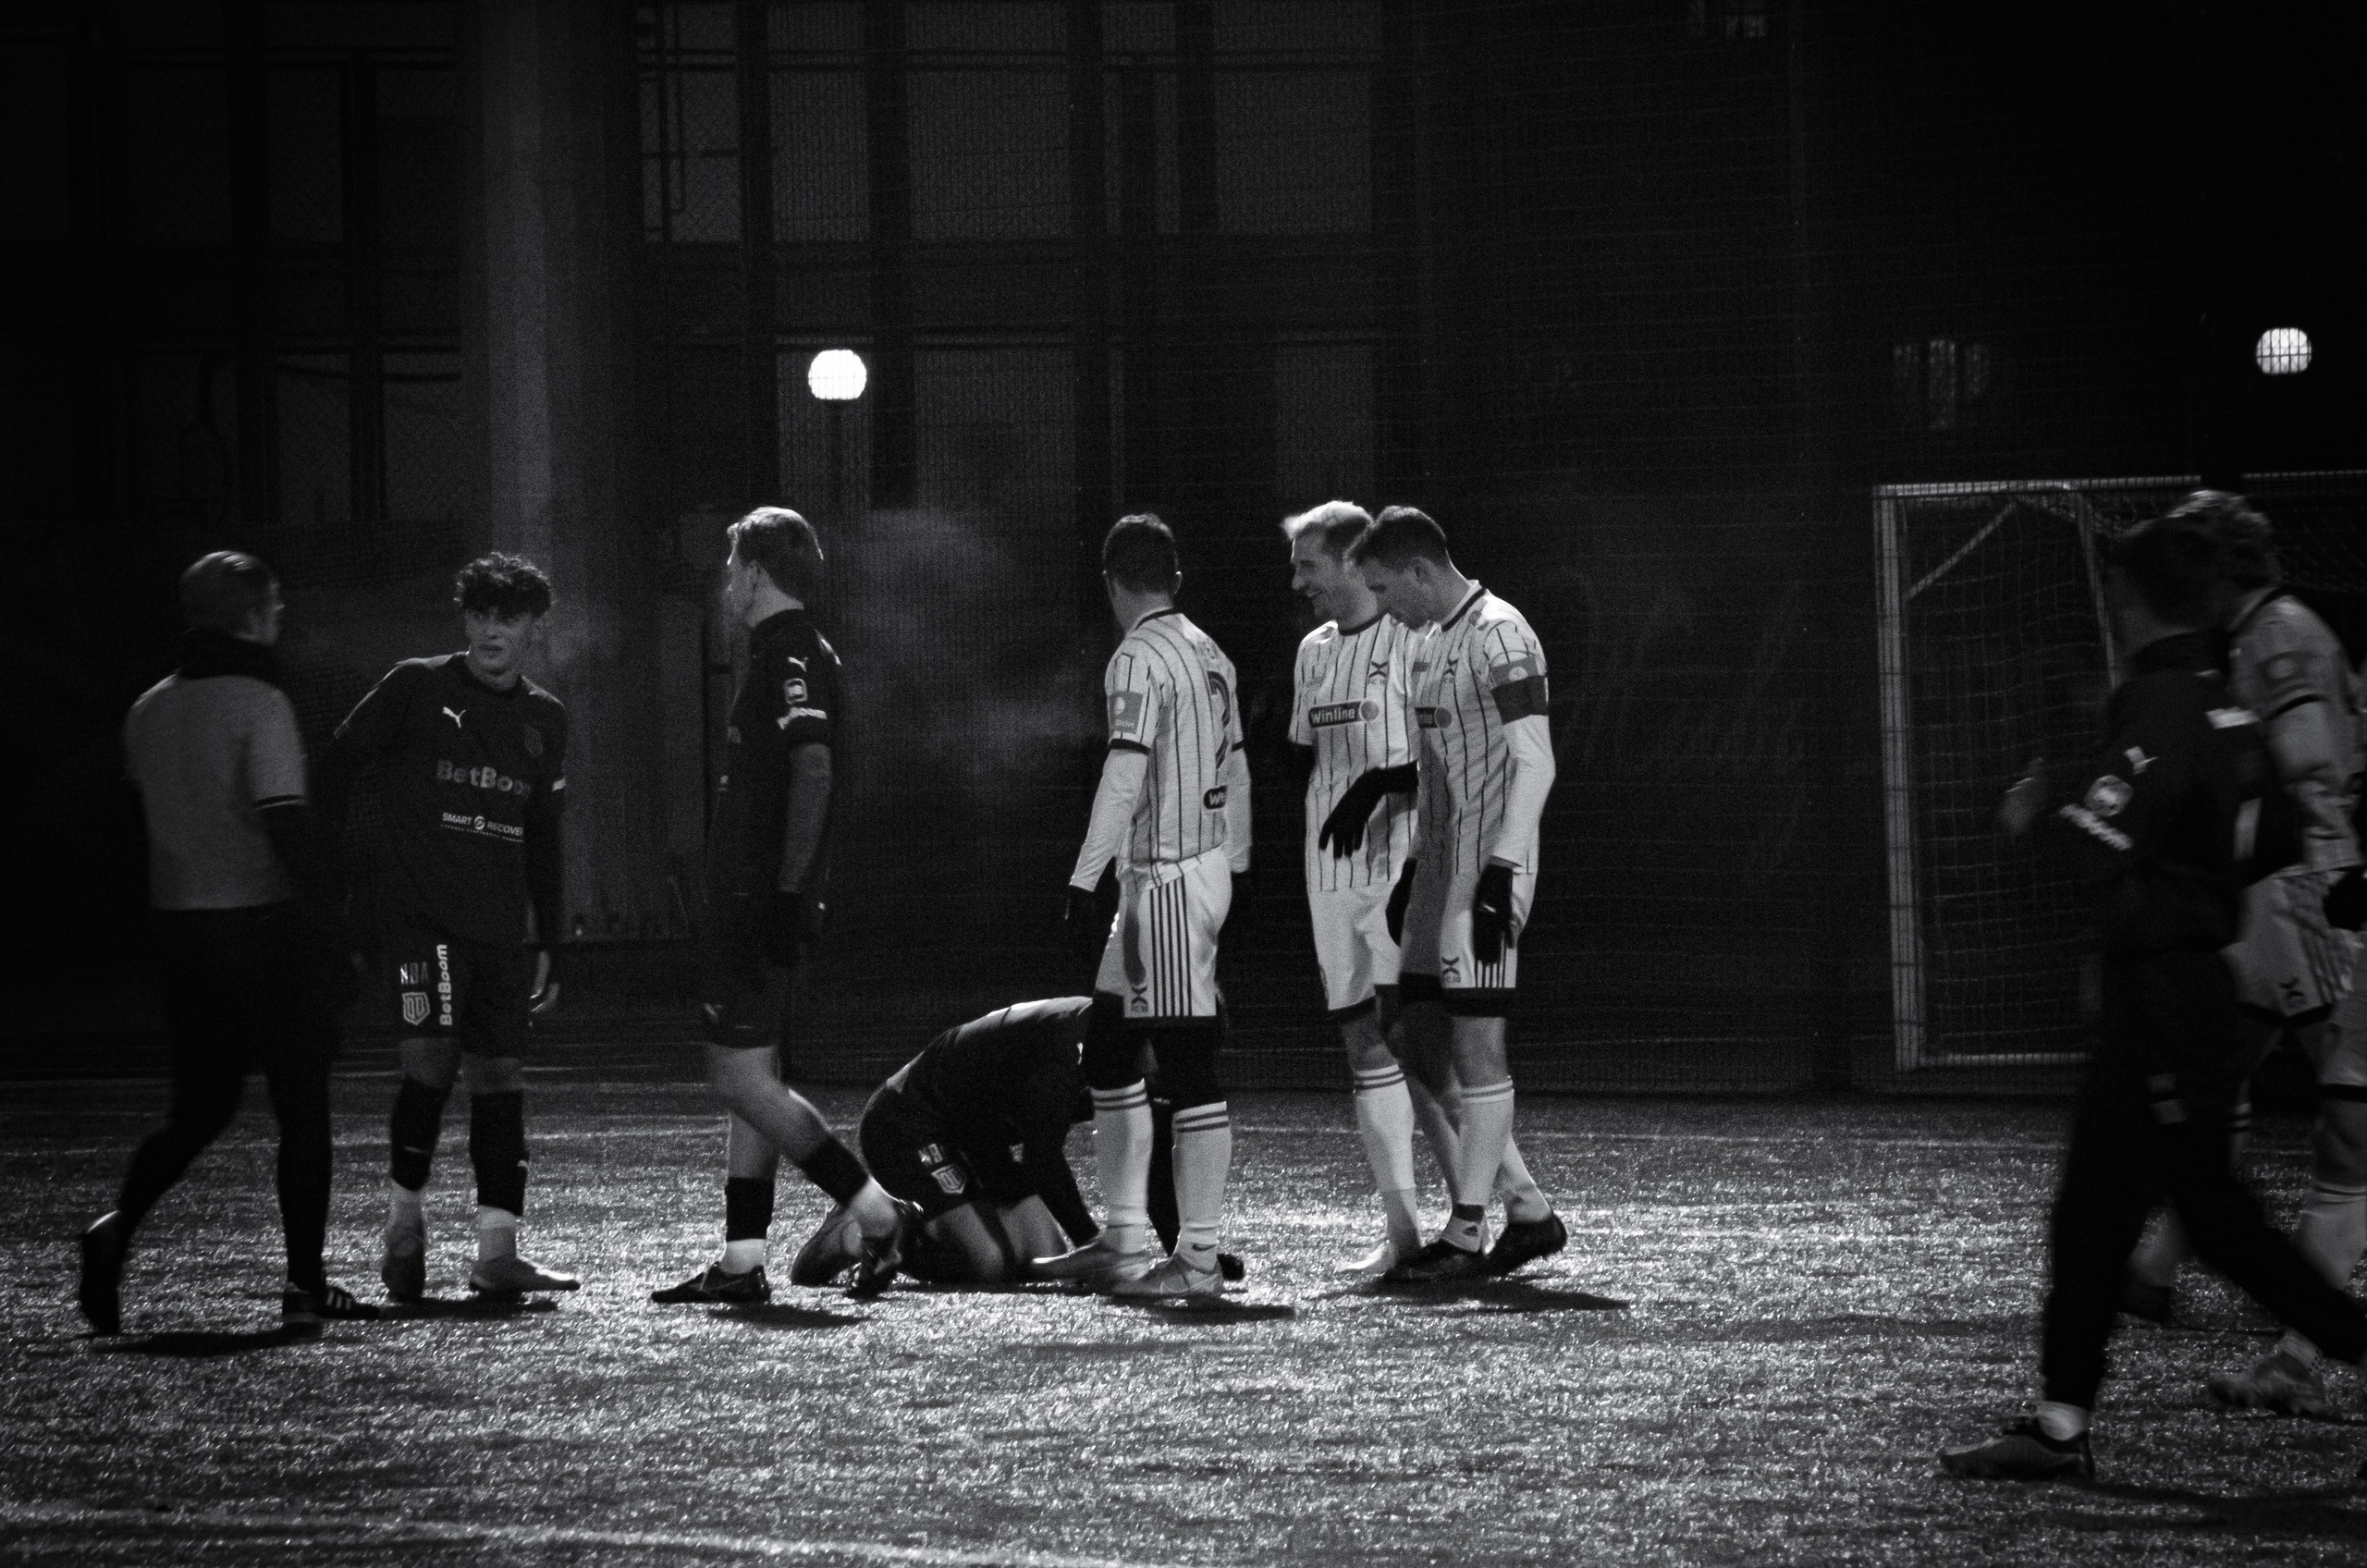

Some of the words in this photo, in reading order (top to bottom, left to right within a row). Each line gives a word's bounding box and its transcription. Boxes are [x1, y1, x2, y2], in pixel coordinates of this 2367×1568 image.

[1310, 706, 1356, 725] Winline
[442, 813, 472, 826] SMART
[486, 821, 523, 836] RECOVE
[436, 944, 453, 1026] BetBoom
